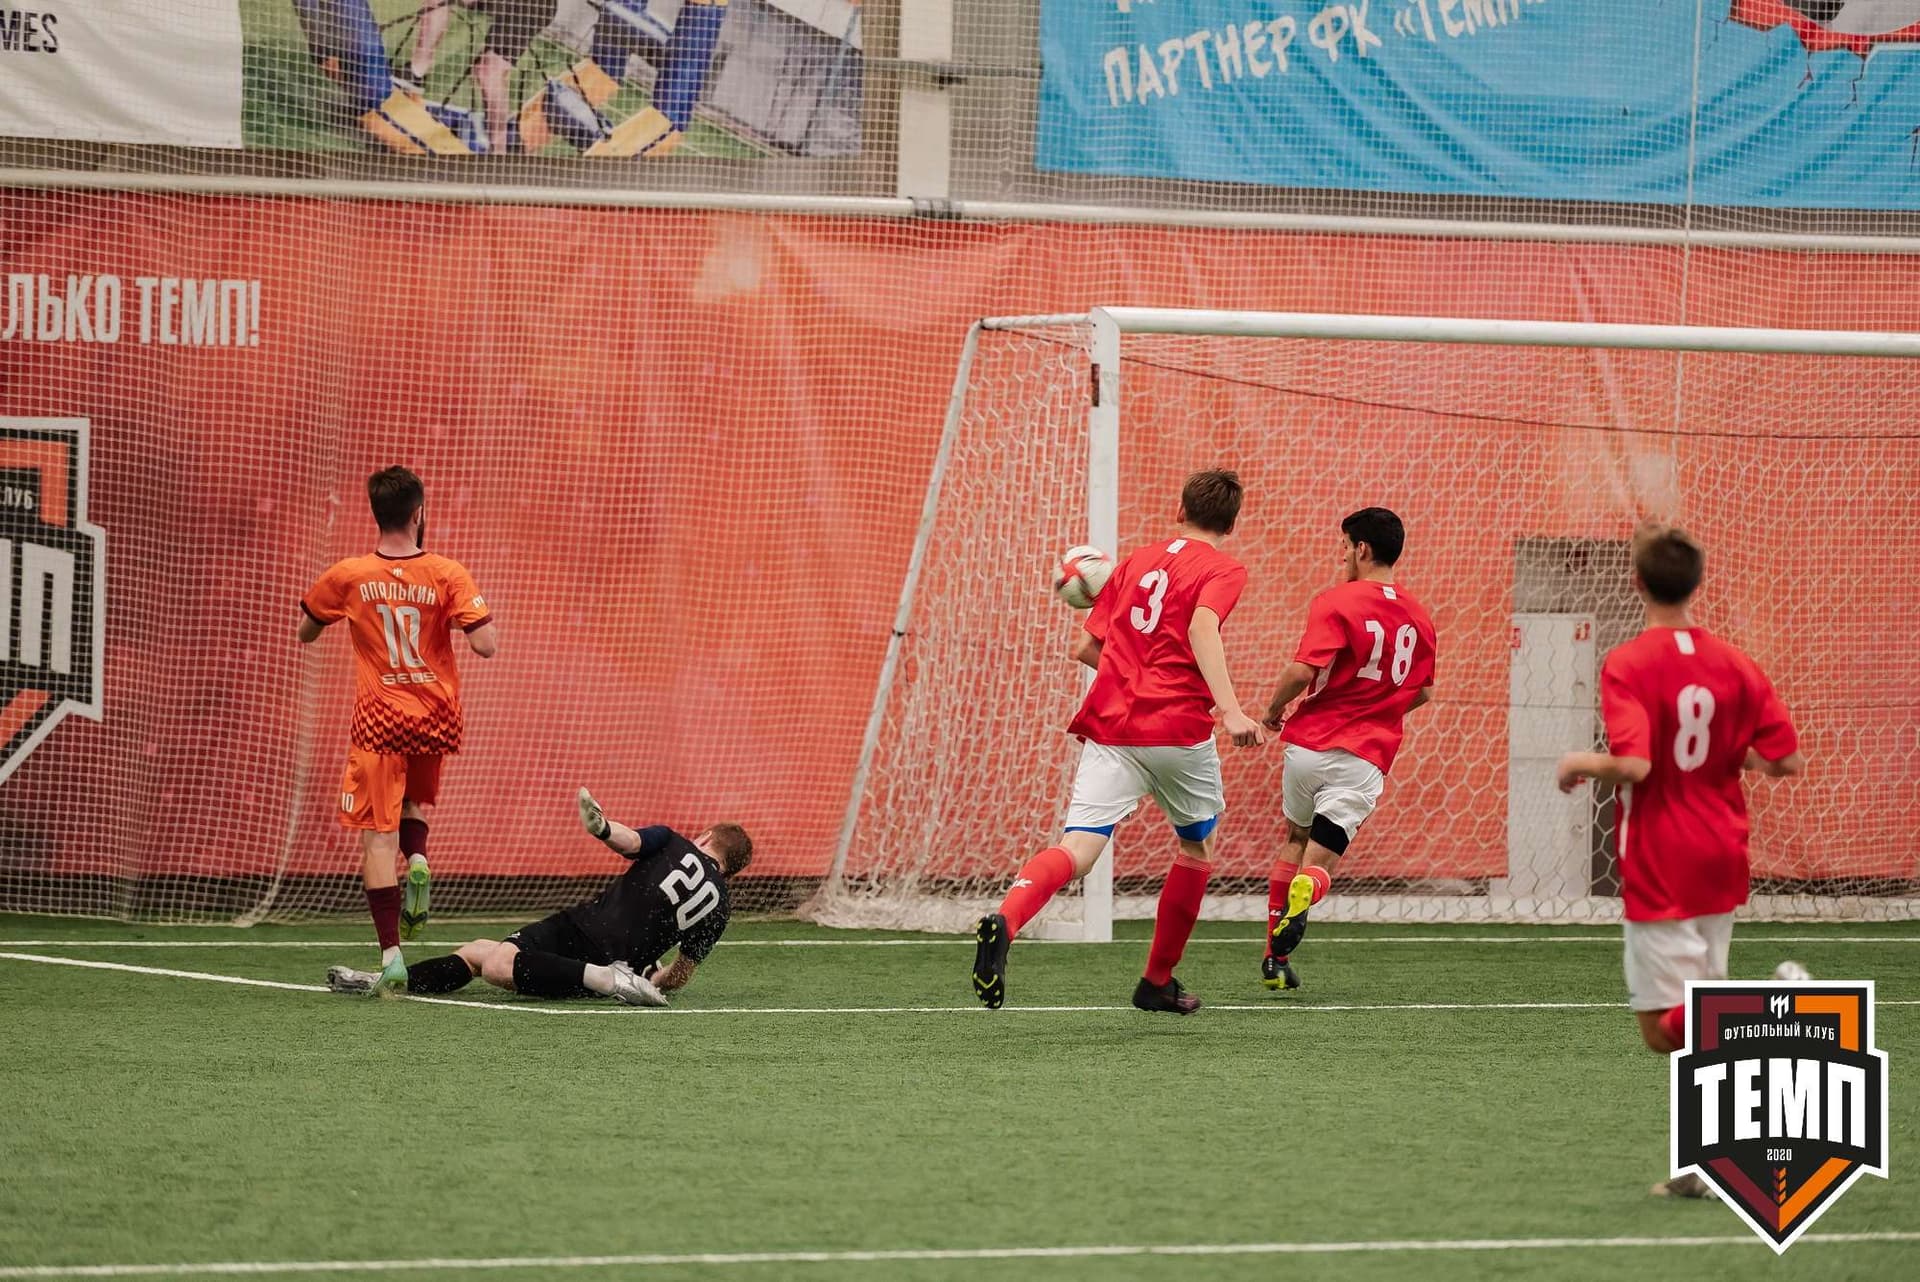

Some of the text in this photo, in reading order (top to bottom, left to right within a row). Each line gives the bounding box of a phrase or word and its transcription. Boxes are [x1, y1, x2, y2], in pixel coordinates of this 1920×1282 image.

[1104, 15, 1297, 108] ПАРТНЕР
[1308, 0, 1382, 62] ФК
[1, 273, 261, 347] ЛЬКО ТЕМП!
[376, 603, 426, 669] 10
[1130, 567, 1169, 634] 3
[1356, 619, 1418, 687] 18
[1673, 684, 1716, 772] 8
[341, 791, 354, 813] 10
[659, 852, 720, 931] 20
